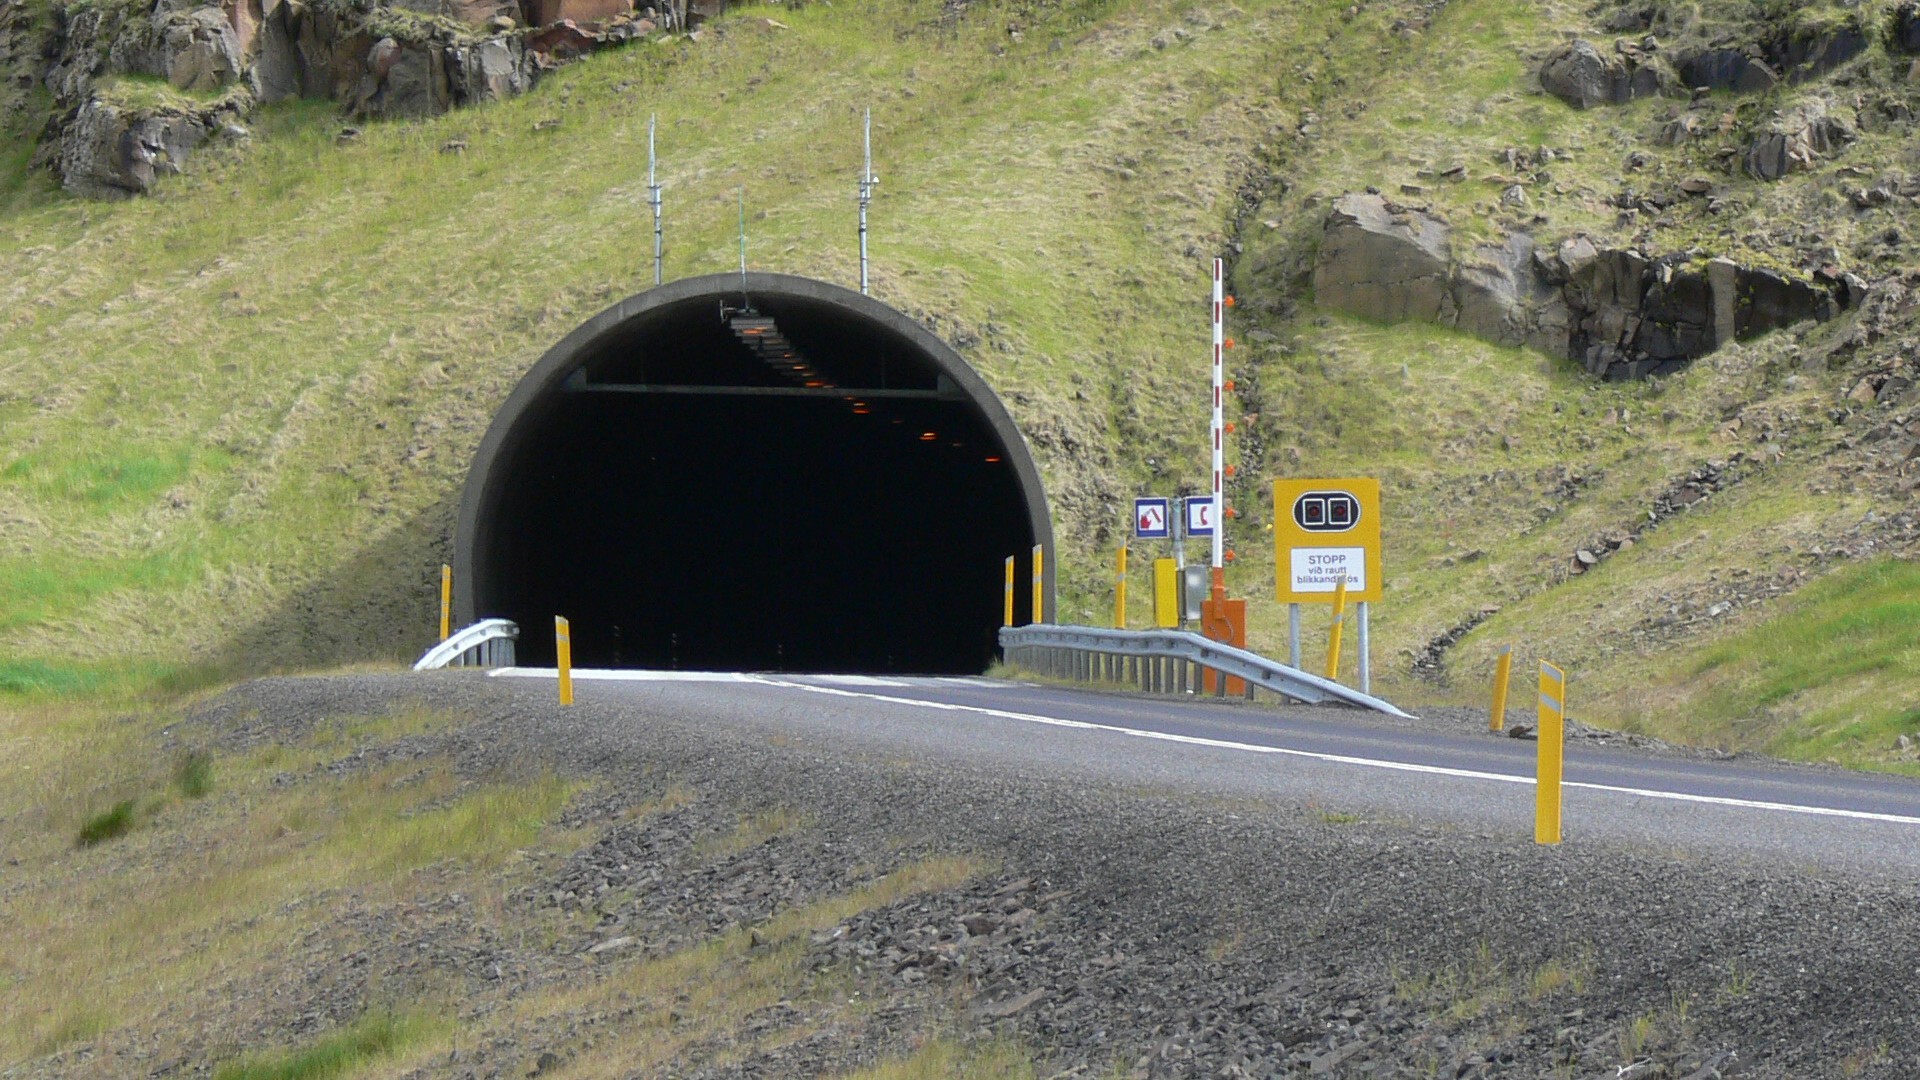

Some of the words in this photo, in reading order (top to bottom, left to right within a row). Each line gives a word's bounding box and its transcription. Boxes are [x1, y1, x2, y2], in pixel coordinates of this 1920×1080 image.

[1308, 555, 1346, 565] STOPP
[1308, 566, 1322, 574] við
[1325, 566, 1347, 574] rautt
